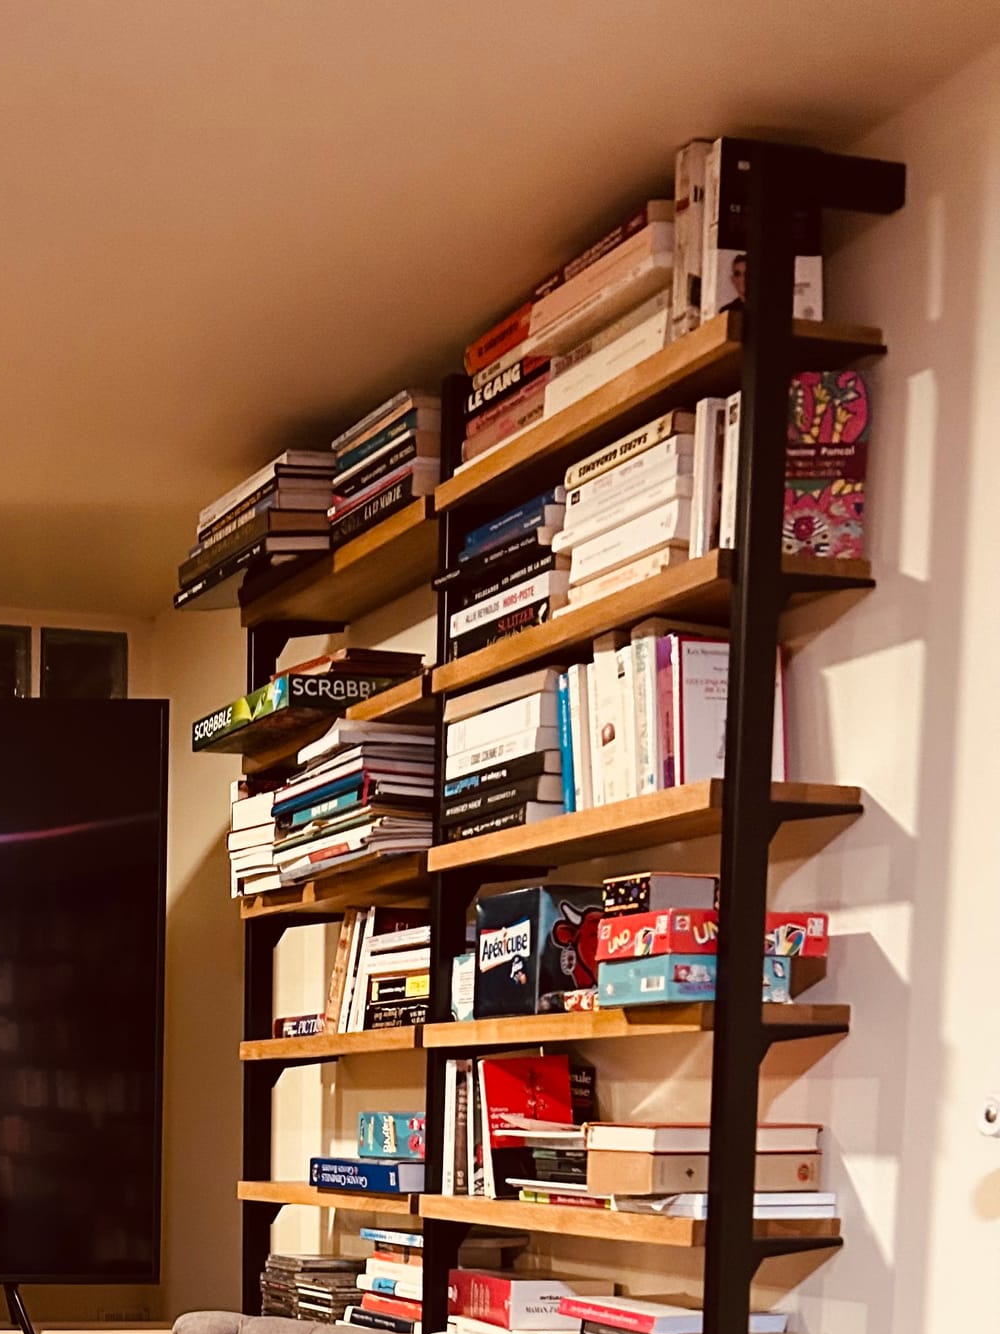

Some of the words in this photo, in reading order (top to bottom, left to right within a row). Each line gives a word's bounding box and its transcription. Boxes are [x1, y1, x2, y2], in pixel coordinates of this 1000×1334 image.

[468, 388, 483, 413] LE
[483, 363, 521, 400] GANG
[497, 607, 535, 633] SULITZER
[194, 706, 233, 741] SCRABBLE
[608, 929, 630, 954] UNO
[693, 921, 718, 944] UN
